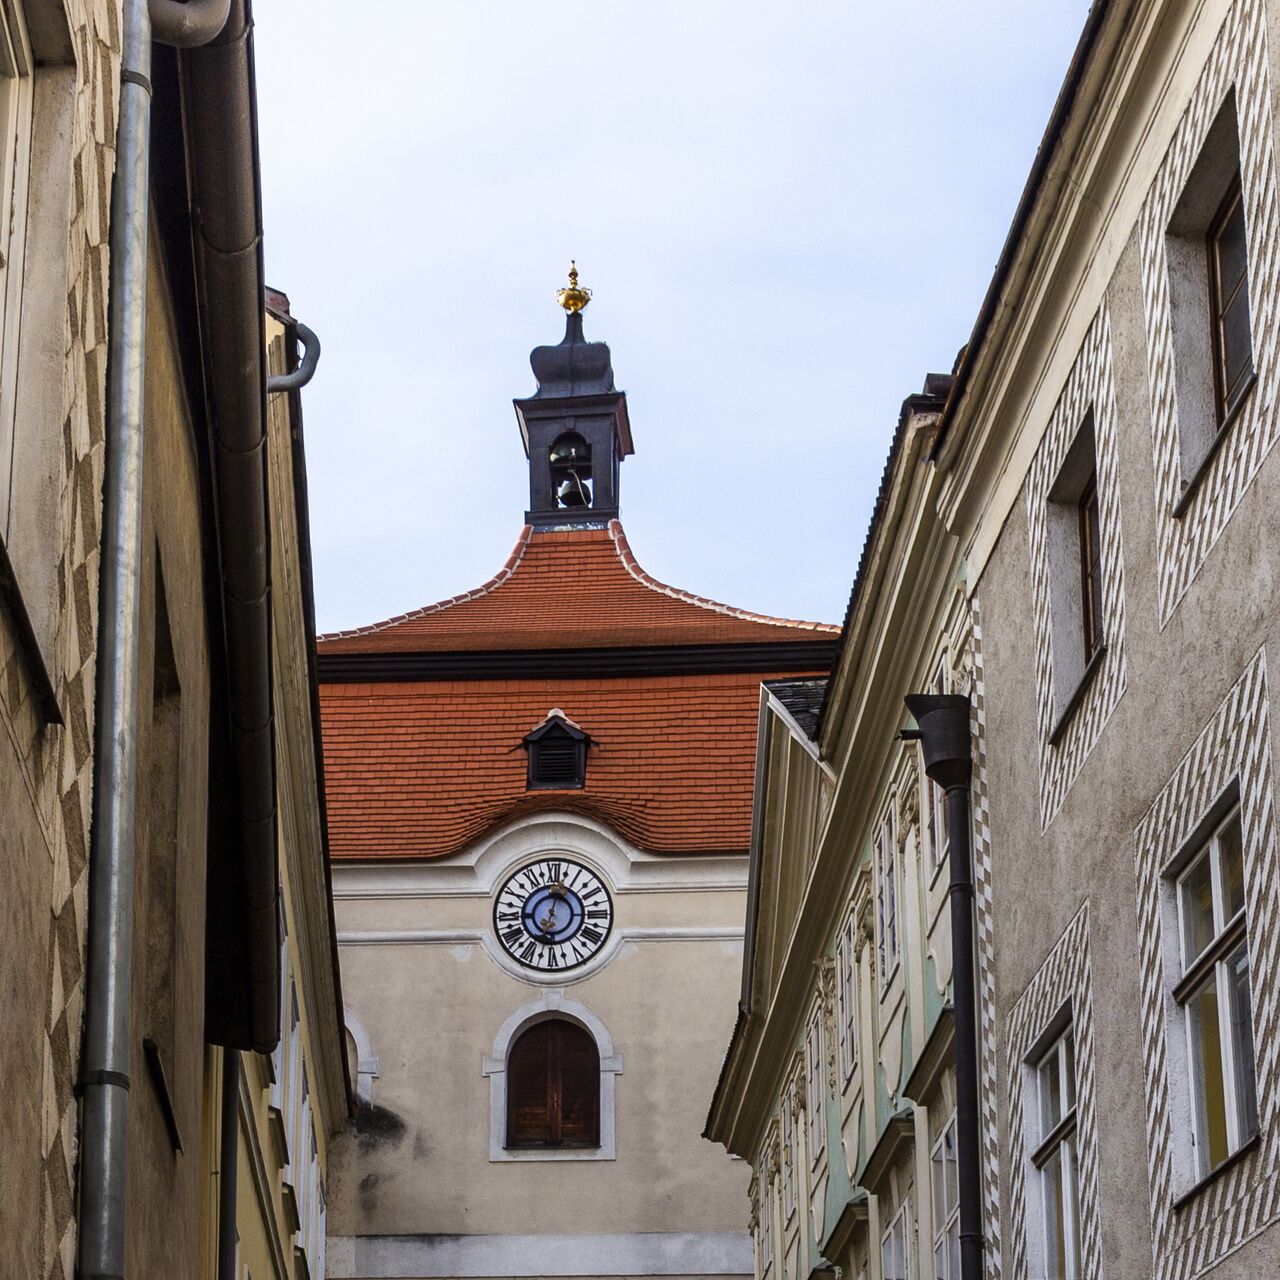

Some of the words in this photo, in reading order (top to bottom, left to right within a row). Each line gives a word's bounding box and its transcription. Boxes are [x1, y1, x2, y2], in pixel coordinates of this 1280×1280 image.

[522, 868, 540, 889] XI
[547, 863, 561, 884] XII
[570, 869, 583, 888] I
[504, 886, 526, 902] X
[582, 886, 602, 900] II
[499, 911, 519, 922] IX
[587, 910, 607, 919] III
[520, 941, 536, 963] VII
[547, 947, 559, 967] VI
[571, 943, 584, 962] V
